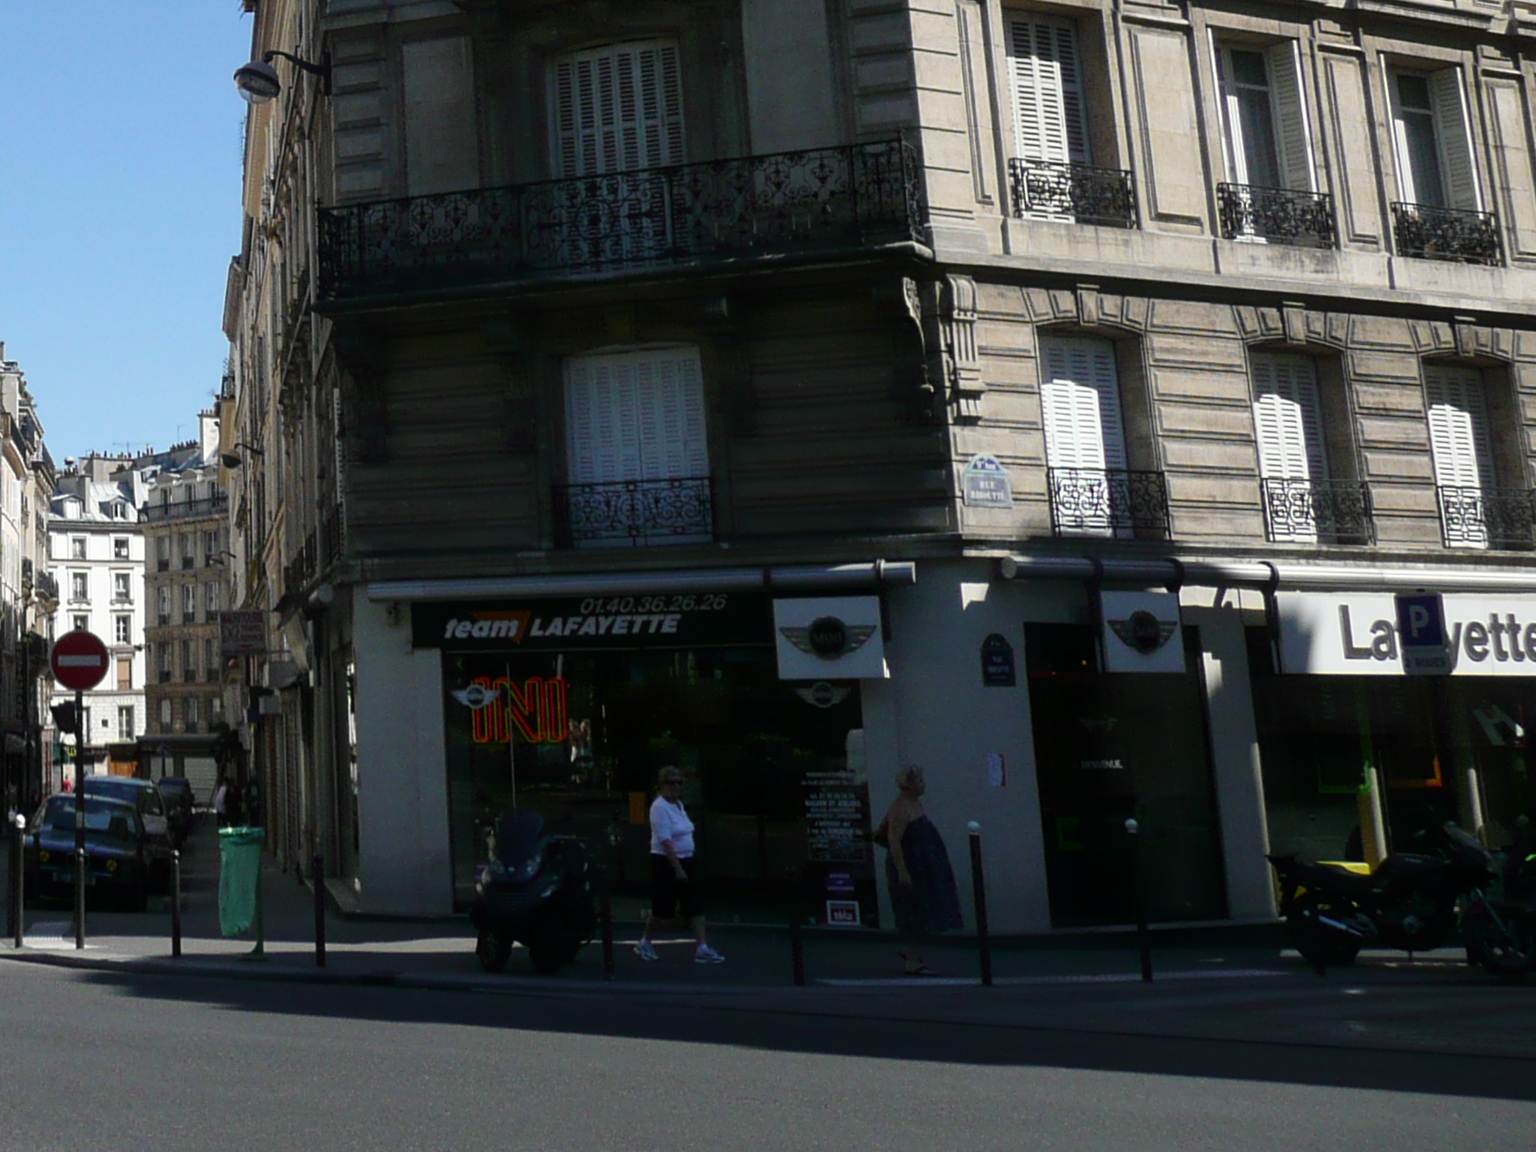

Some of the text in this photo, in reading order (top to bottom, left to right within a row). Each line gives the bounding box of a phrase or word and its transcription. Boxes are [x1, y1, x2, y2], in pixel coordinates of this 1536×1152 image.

[579, 594, 728, 615] 01.40.36.26.26
[443, 613, 682, 640] team LAFAYETTE
[1409, 604, 1430, 638] P
[813, 631, 843, 643] MINI
